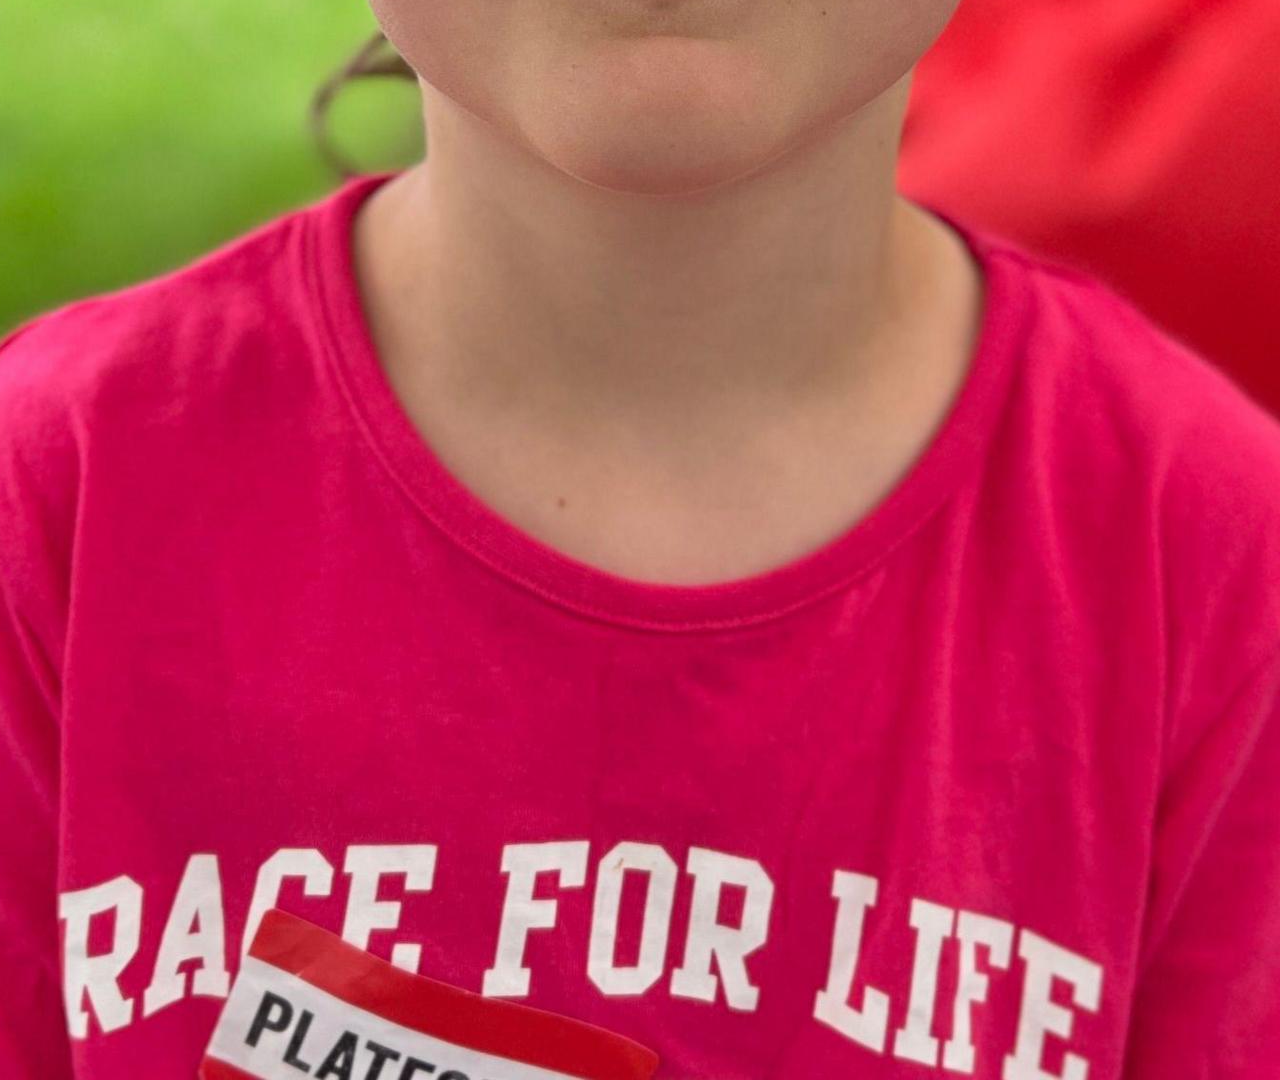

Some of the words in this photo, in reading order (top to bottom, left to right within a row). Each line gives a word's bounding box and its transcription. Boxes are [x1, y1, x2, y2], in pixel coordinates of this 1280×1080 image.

[58, 844, 438, 1039] RACE
[481, 840, 775, 1012] FOR
[813, 869, 1103, 1080] LIFE
[244, 990, 469, 1080] PLAT
